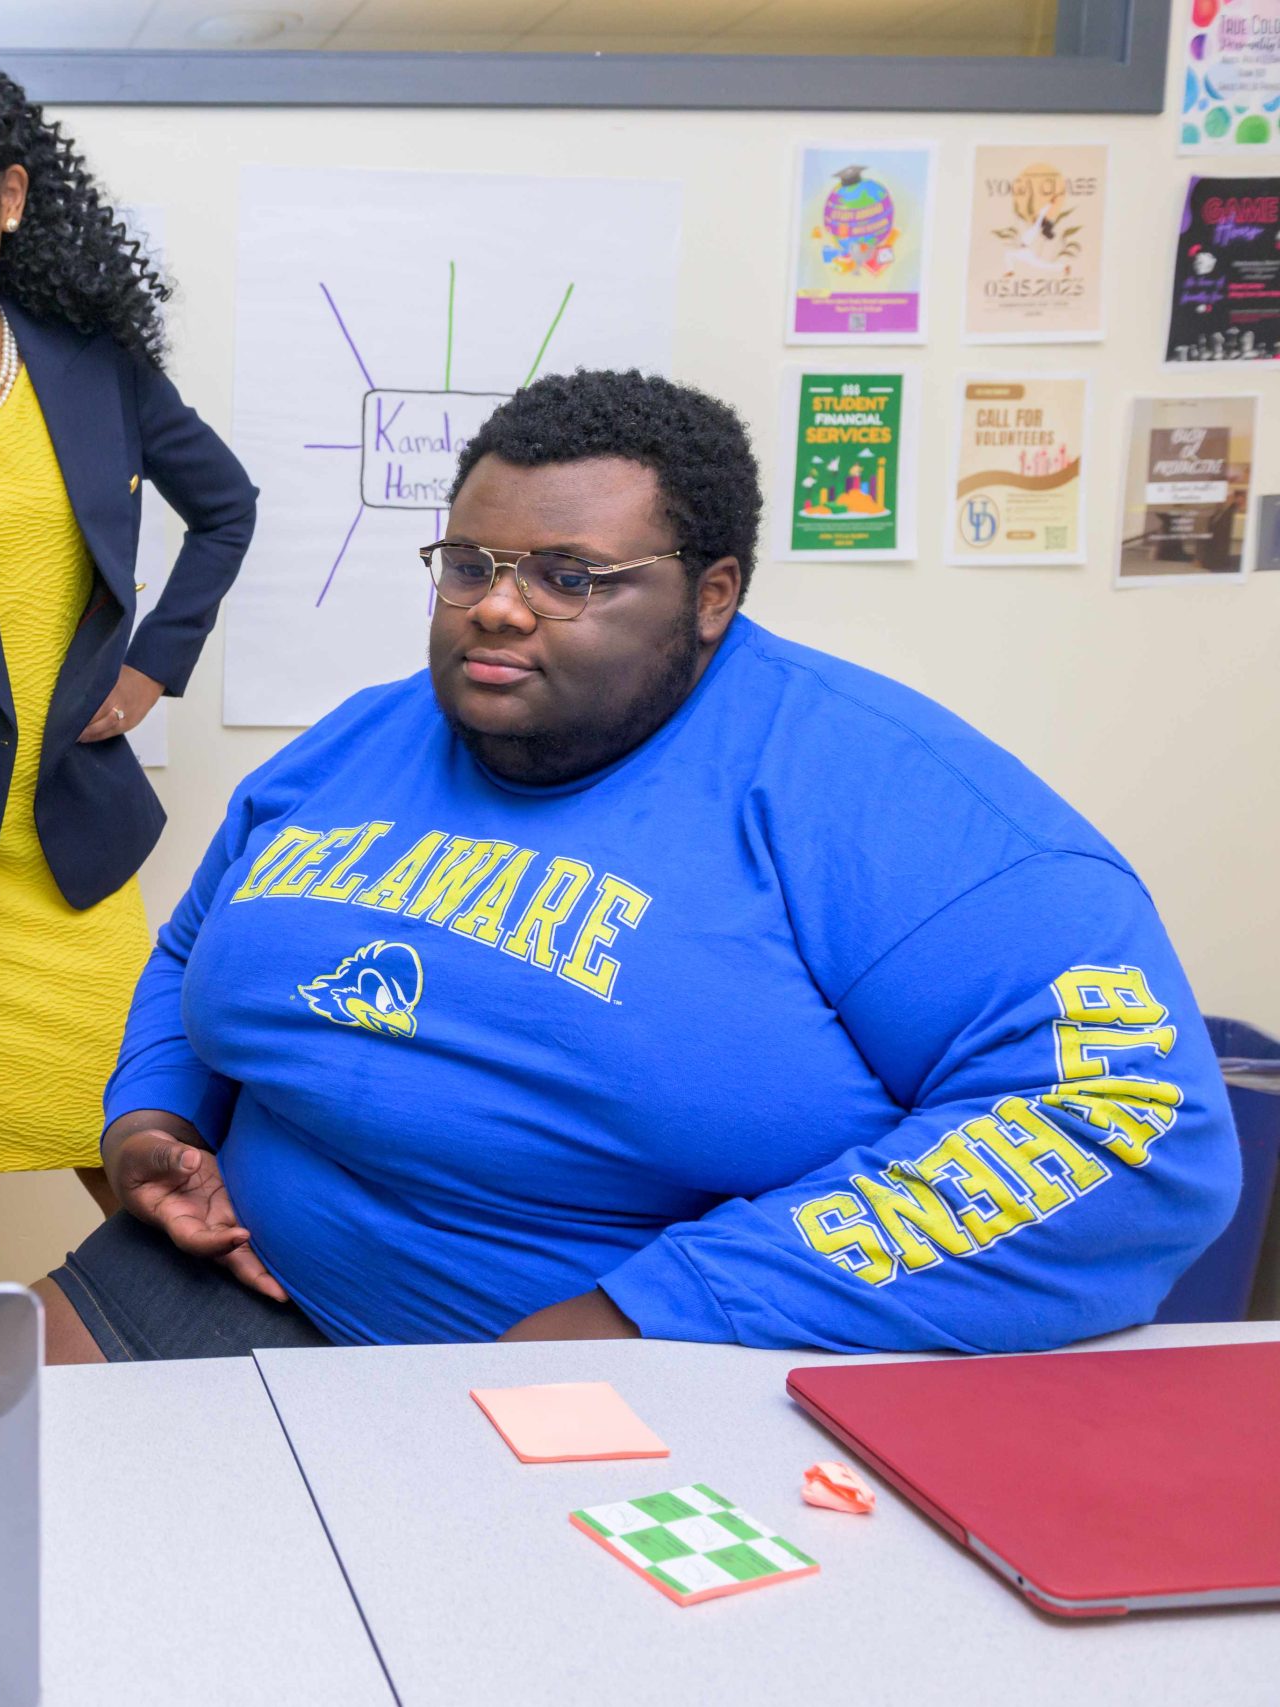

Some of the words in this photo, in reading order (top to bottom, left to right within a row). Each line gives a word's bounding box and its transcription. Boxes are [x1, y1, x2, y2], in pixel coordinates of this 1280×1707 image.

[812, 396, 889, 412] STUDENT
[814, 412, 883, 426] FINANCIAL
[976, 407, 1010, 428] CALL
[1016, 407, 1043, 428] FOR
[805, 427, 892, 444] SERVICES
[975, 430, 1056, 446] VOLUNTEERS
[230, 821, 652, 1002] DELAWARE
[792, 1096, 1113, 1288] HENS
